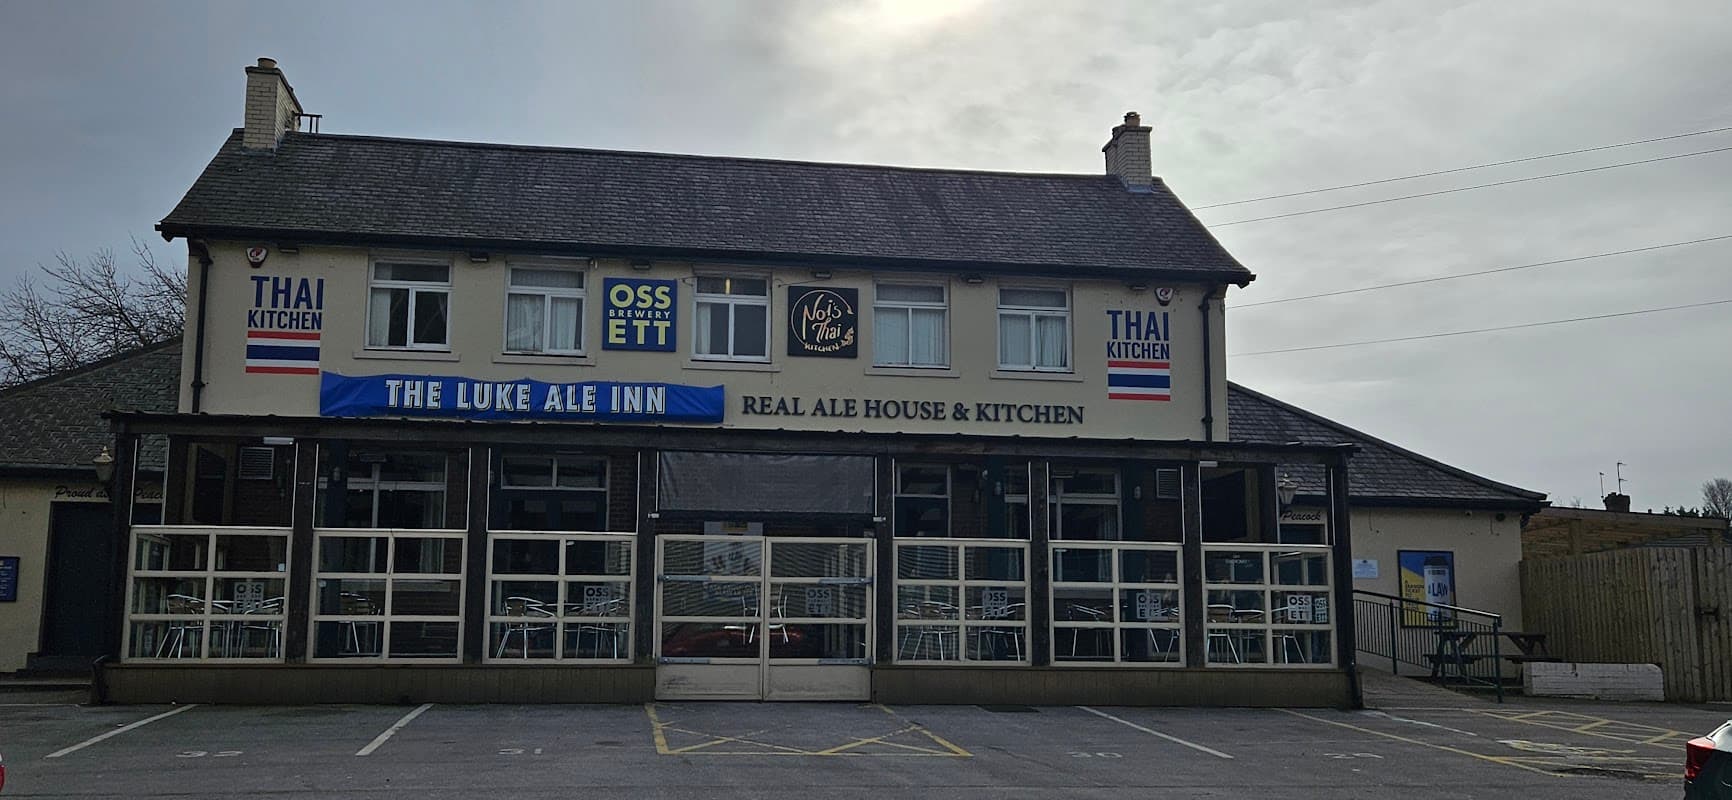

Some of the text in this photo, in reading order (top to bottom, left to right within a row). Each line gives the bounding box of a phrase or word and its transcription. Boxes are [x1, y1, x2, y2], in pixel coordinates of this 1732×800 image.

[250, 275, 325, 310] THAI
[609, 283, 672, 310] OSS
[247, 309, 323, 330] KITCHEN
[609, 309, 671, 319] BREWERY
[802, 293, 842, 341] Noi's
[608, 318, 671, 345] ETT
[811, 317, 842, 344] Thai
[1106, 310, 1169, 341] THAI
[804, 342, 840, 352] KITCHEN
[1107, 341, 1170, 360] KITCHEN
[385, 379, 666, 414] THE LUKE ALE INN
[741, 395, 1085, 425] REAL ALE HOUSE & KITCHEN
[55, 485, 95, 499] Proud
[1281, 510, 1321, 521] Peacock
[586, 587, 609, 597] OSS
[807, 589, 830, 599] OSS
[1432, 583, 1448, 598] LAW
[1289, 596, 1310, 606] OSS
[1291, 610, 1310, 620] ETT
